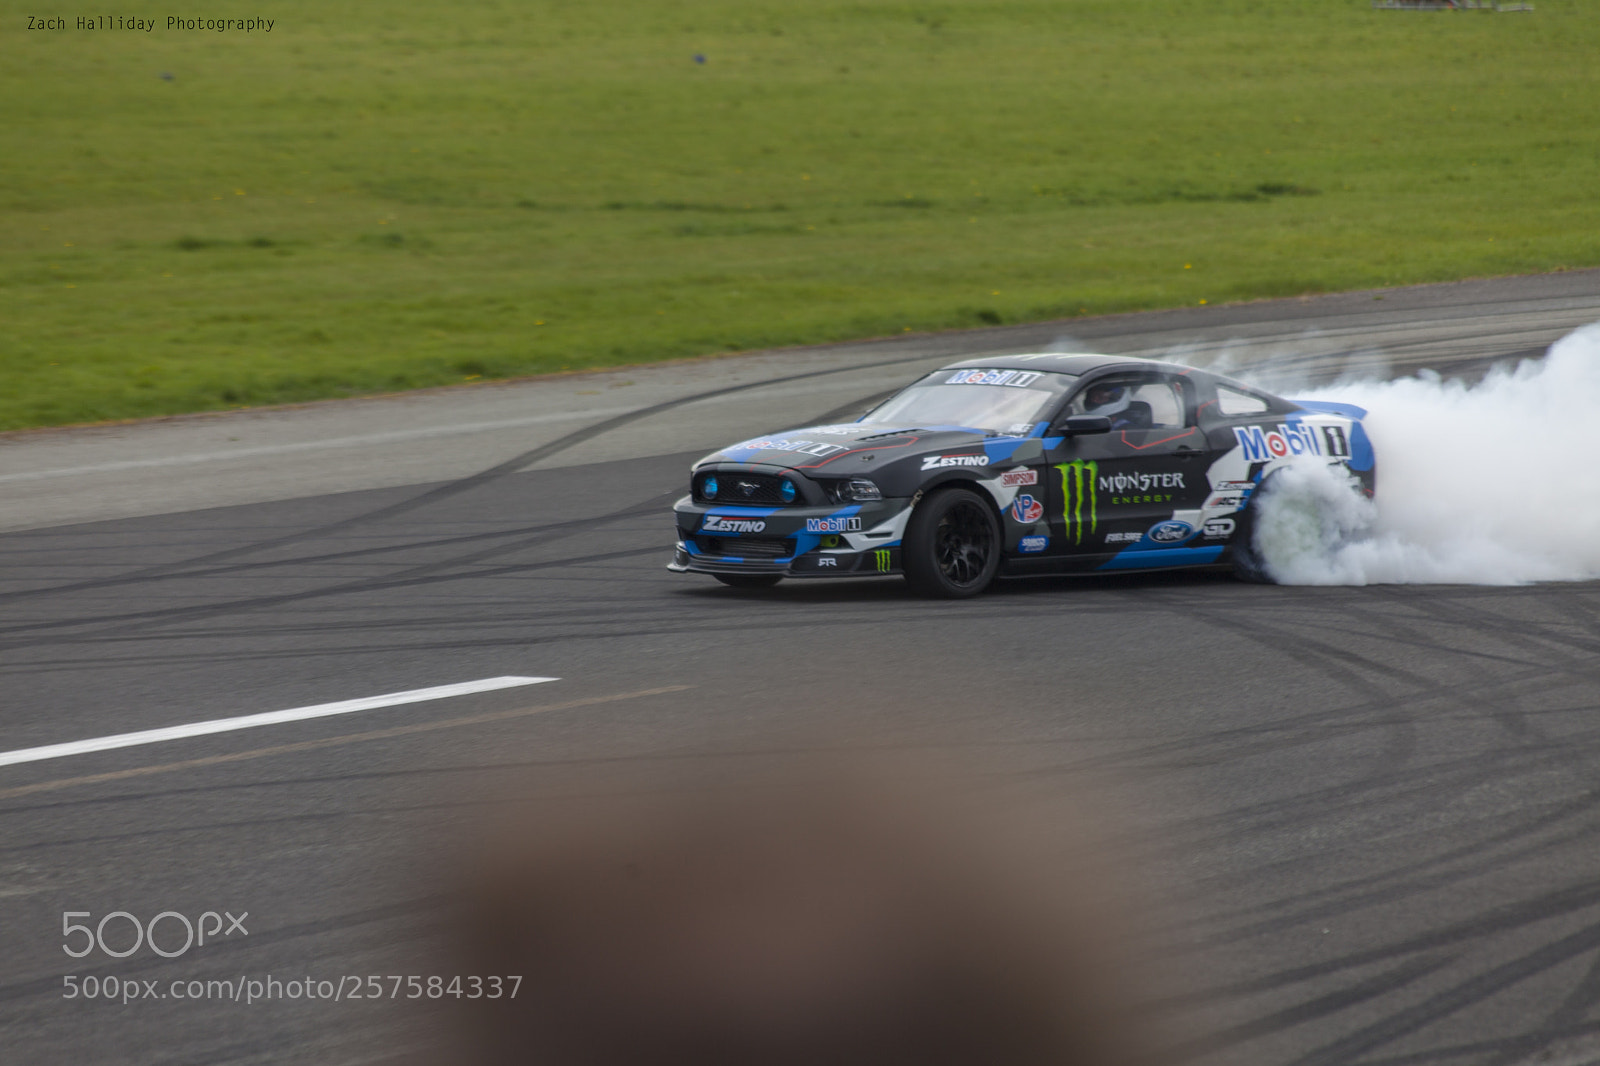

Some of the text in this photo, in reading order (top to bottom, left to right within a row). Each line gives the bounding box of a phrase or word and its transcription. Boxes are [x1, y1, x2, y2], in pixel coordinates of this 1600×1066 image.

[945, 370, 1018, 385] Mobil
[1232, 424, 1322, 462] Mobil
[920, 455, 989, 471] ZESTINO
[1003, 472, 1034, 485] SIMPSON
[1112, 494, 1172, 504] ENERGY
[703, 516, 766, 533] ZESTINO
[807, 518, 846, 531] Mobil
